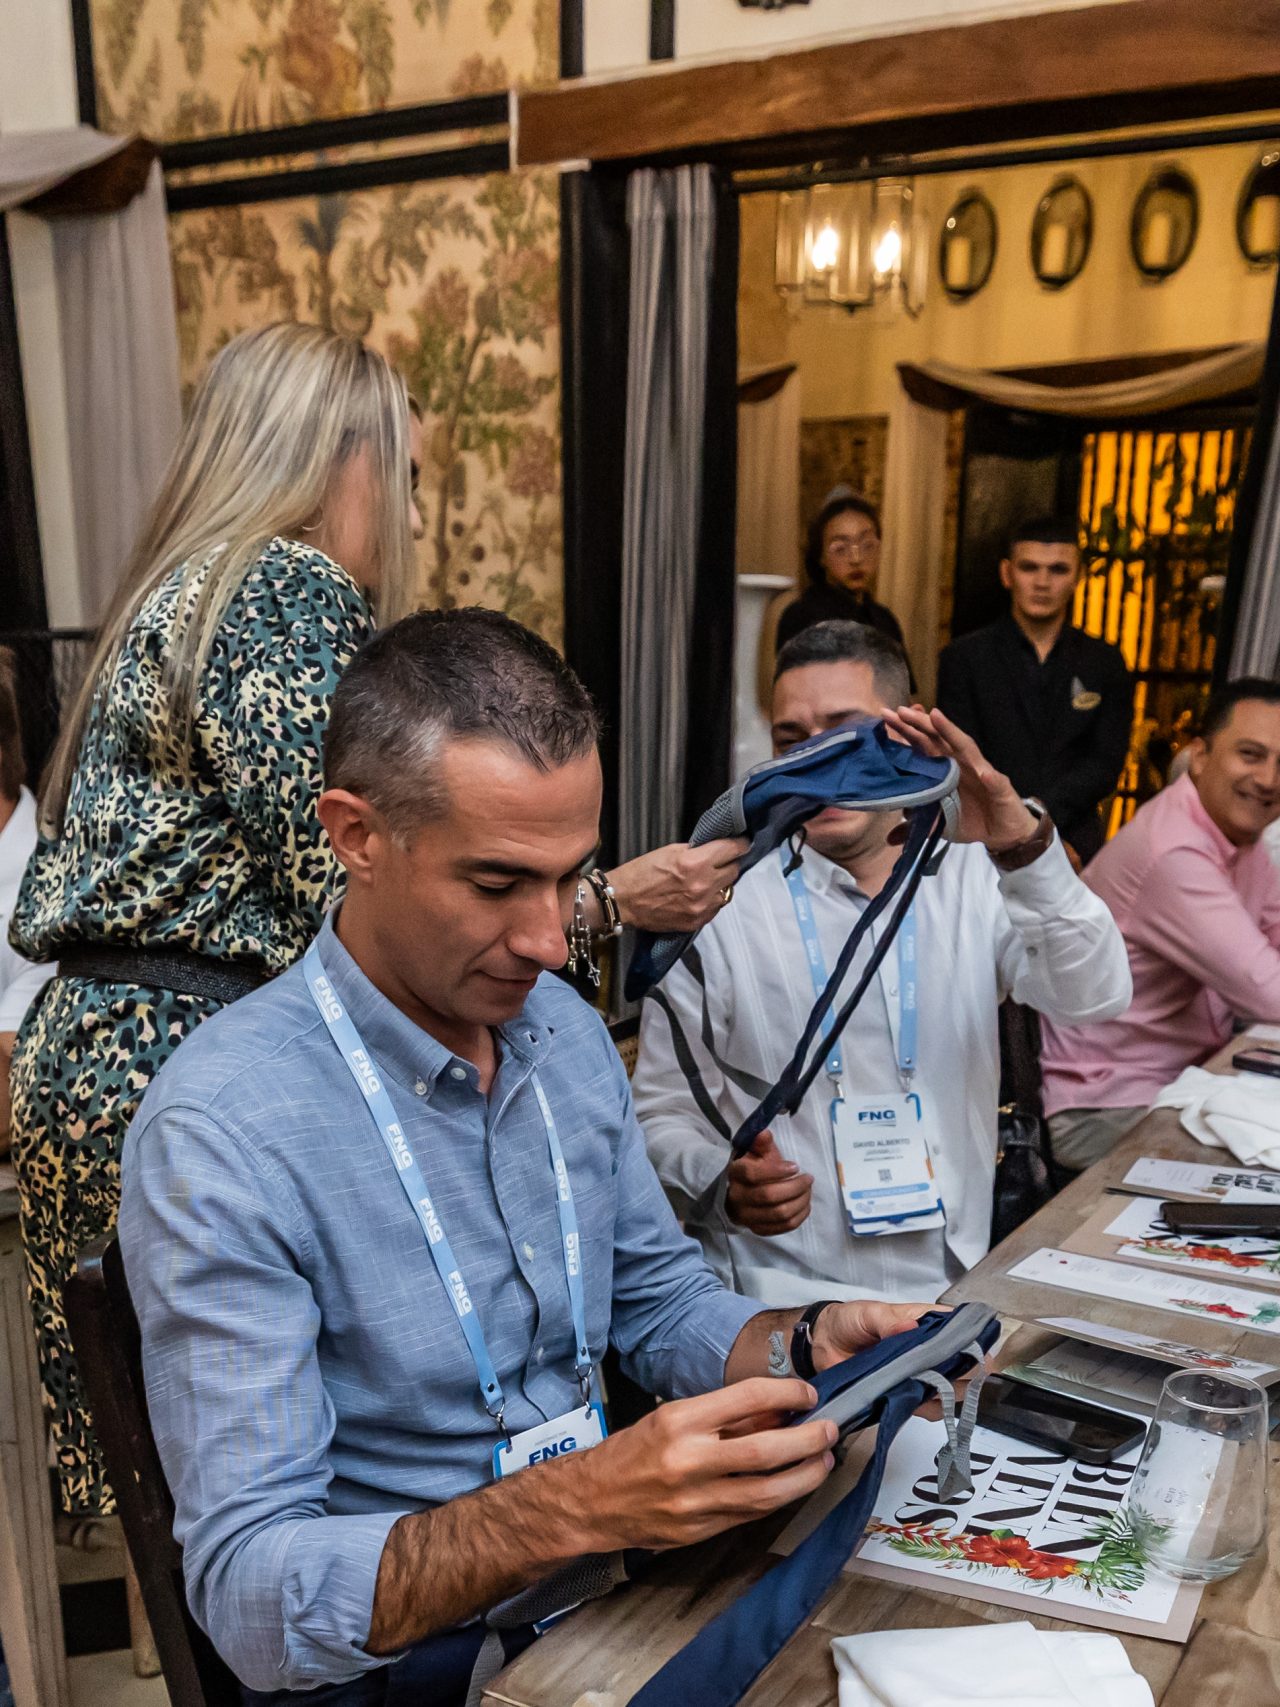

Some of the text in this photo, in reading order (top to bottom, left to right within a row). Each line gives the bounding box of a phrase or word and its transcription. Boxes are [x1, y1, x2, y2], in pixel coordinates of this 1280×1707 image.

[313, 975, 343, 1022] FNG
[351, 1048, 381, 1095] FNG
[858, 1109, 896, 1122] FNG
[388, 1122, 414, 1170] FNG
[418, 1197, 444, 1244] FNG
[448, 1270, 474, 1316] FNG
[528, 1436, 577, 1467] FNG
